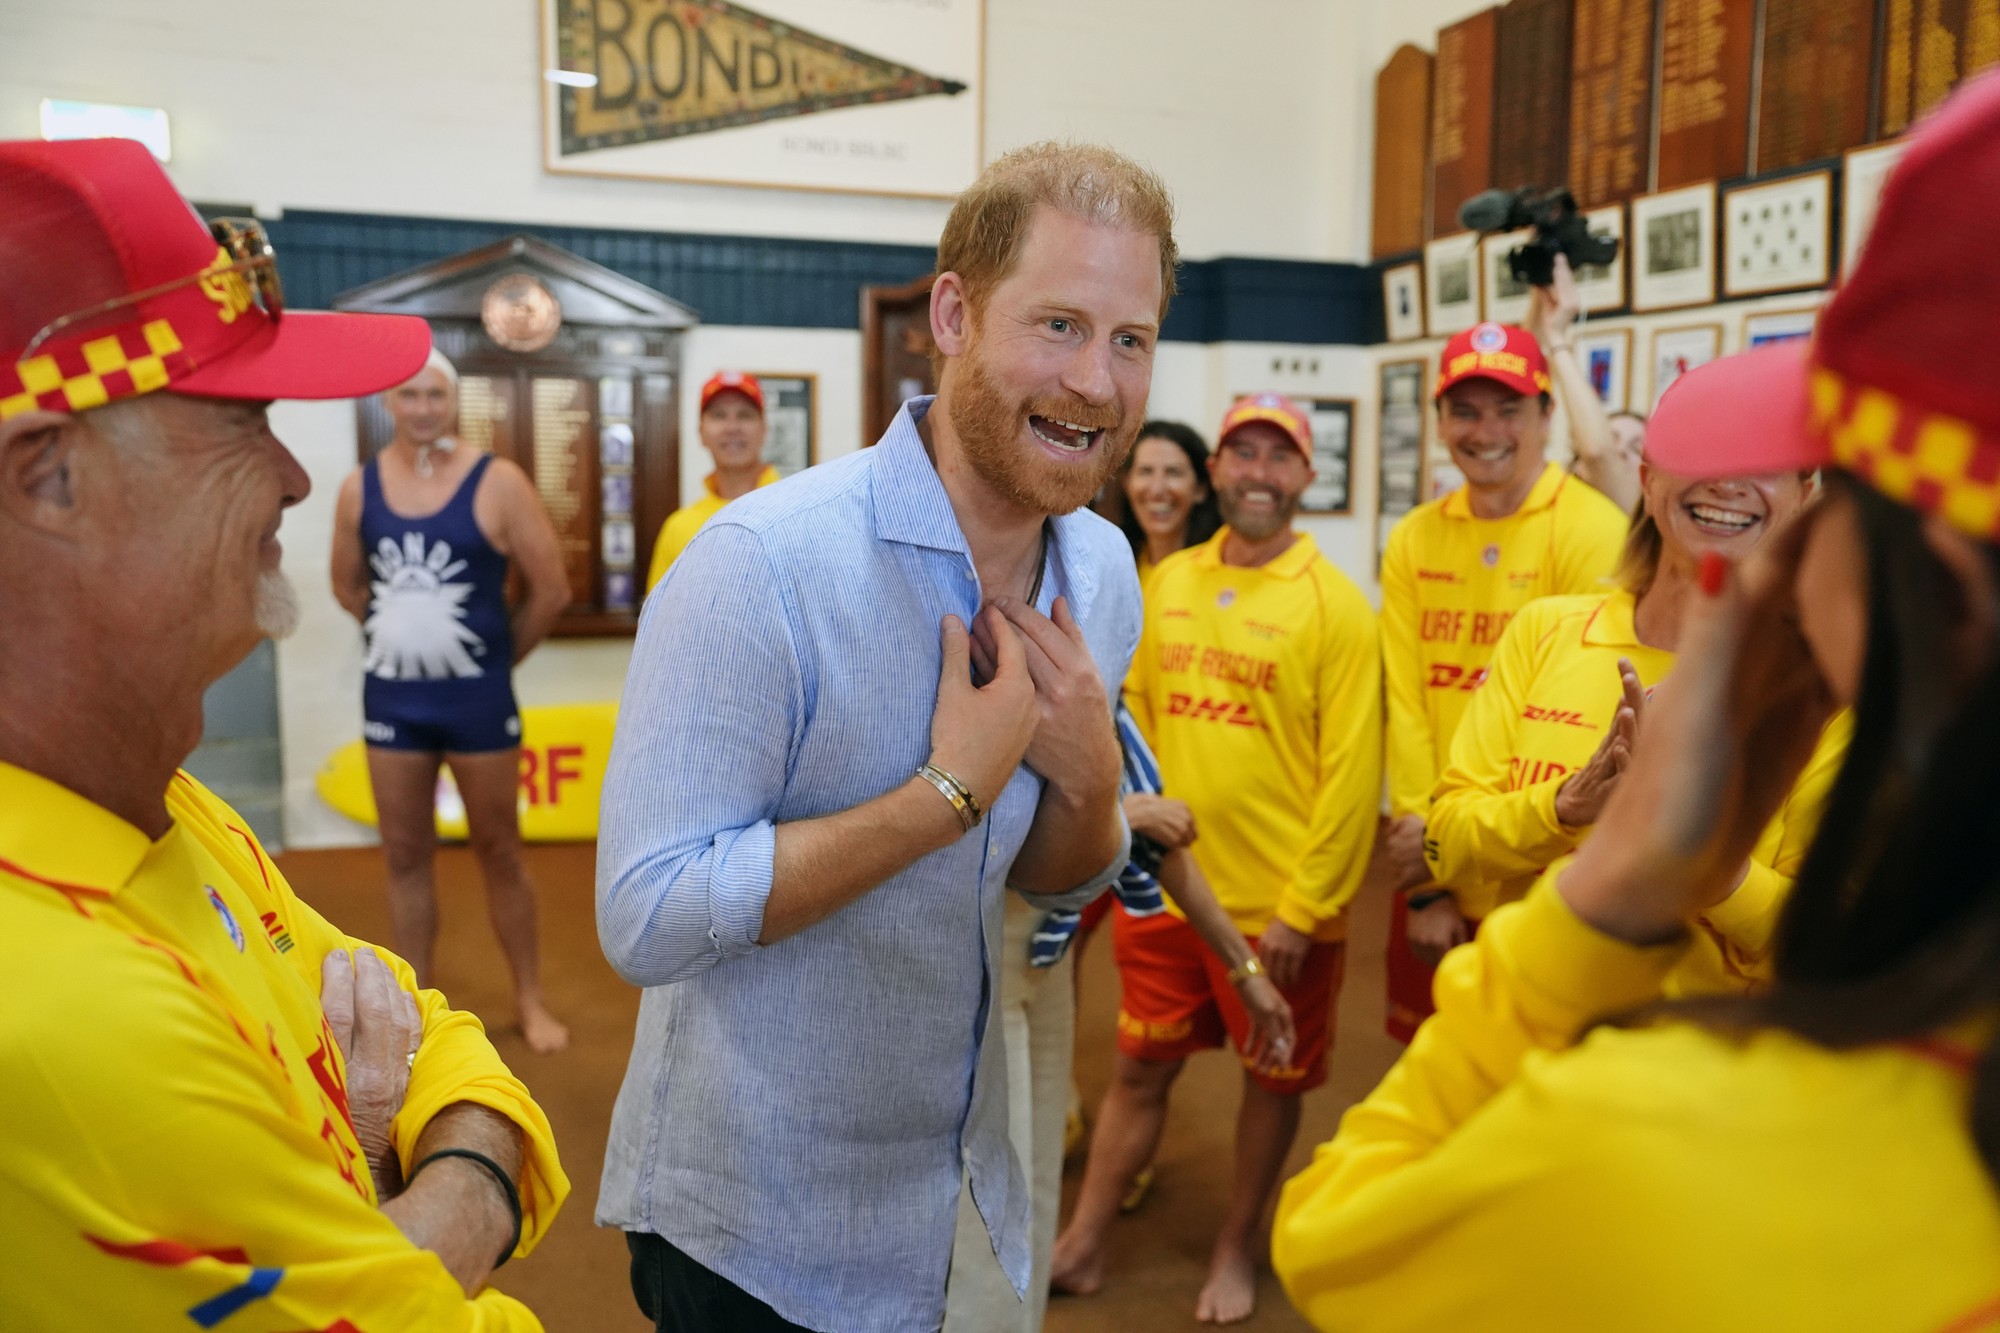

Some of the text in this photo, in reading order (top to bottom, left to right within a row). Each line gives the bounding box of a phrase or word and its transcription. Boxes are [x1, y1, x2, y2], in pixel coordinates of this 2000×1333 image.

[593, 0, 799, 111] BONDI
[1420, 609, 1465, 644] URF
[1200, 645, 1278, 694] RESCUE
[1168, 692, 1256, 728] DHL
[1522, 704, 1583, 726] DHL
